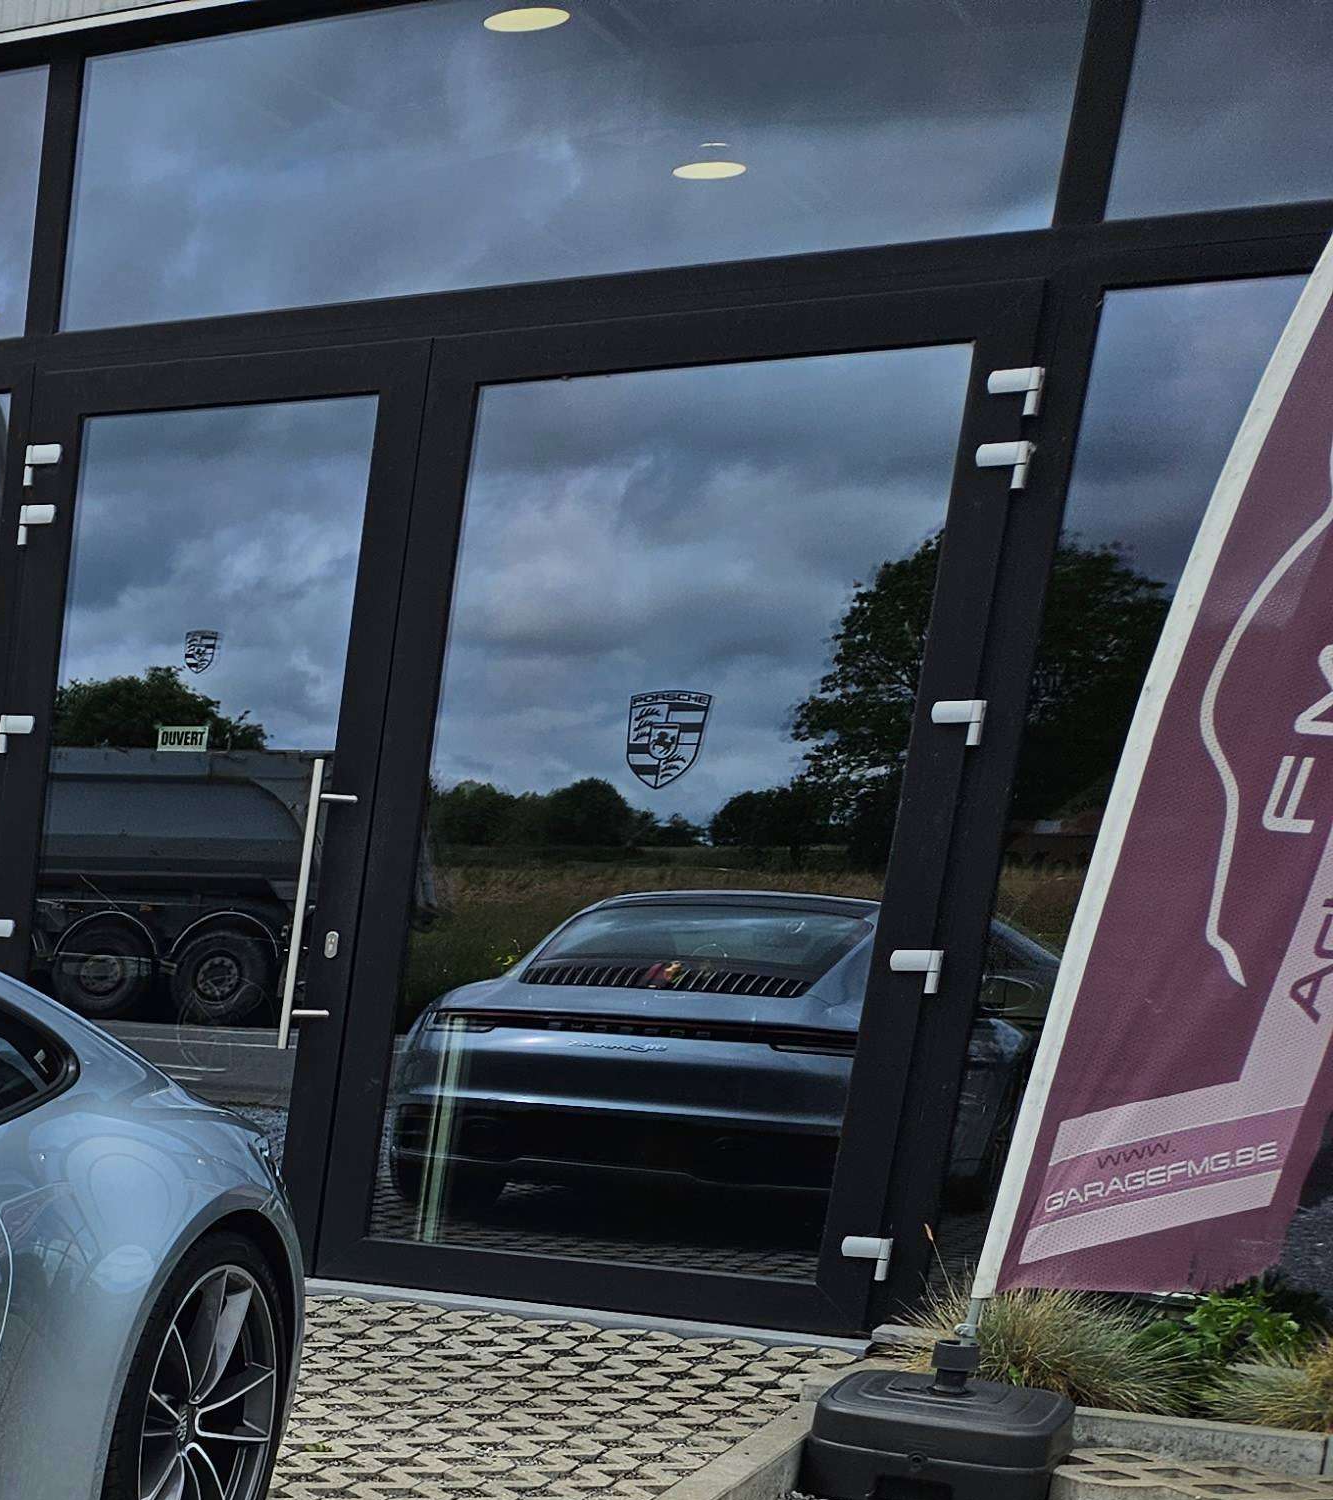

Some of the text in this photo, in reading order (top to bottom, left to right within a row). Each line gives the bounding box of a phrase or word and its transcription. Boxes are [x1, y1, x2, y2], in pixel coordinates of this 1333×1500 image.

[633, 693, 709, 705] PORSCHE
[161, 730, 206, 746] OUVERT
[1044, 1141, 1278, 1213] GARAGEFMG.BE
